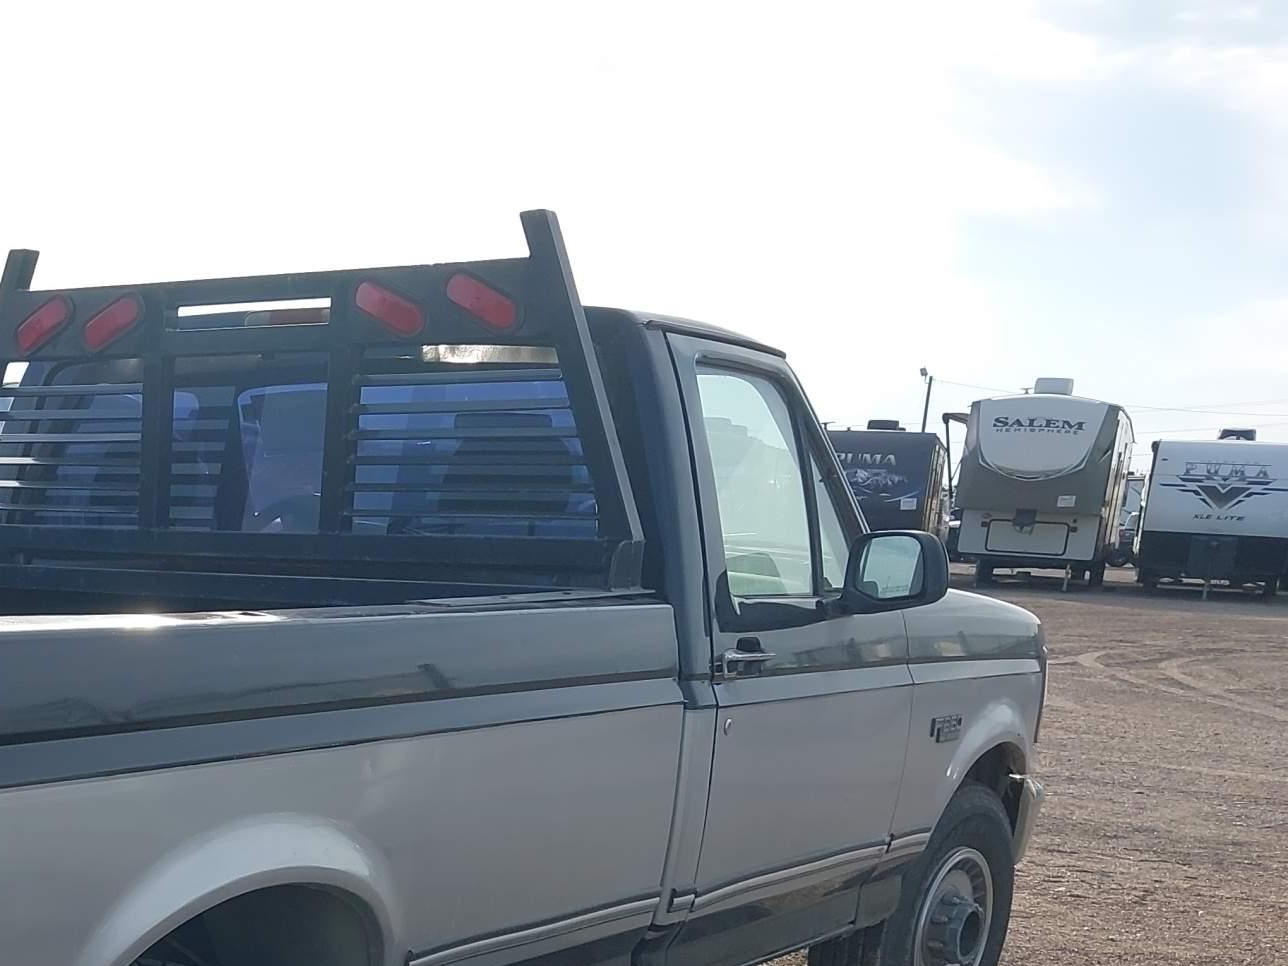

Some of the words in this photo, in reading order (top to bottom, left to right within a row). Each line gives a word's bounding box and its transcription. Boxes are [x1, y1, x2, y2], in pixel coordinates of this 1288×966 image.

[992, 416, 1088, 431] SALEM
[836, 452, 896, 466] PUMA
[1185, 463, 1270, 478] PUMA
